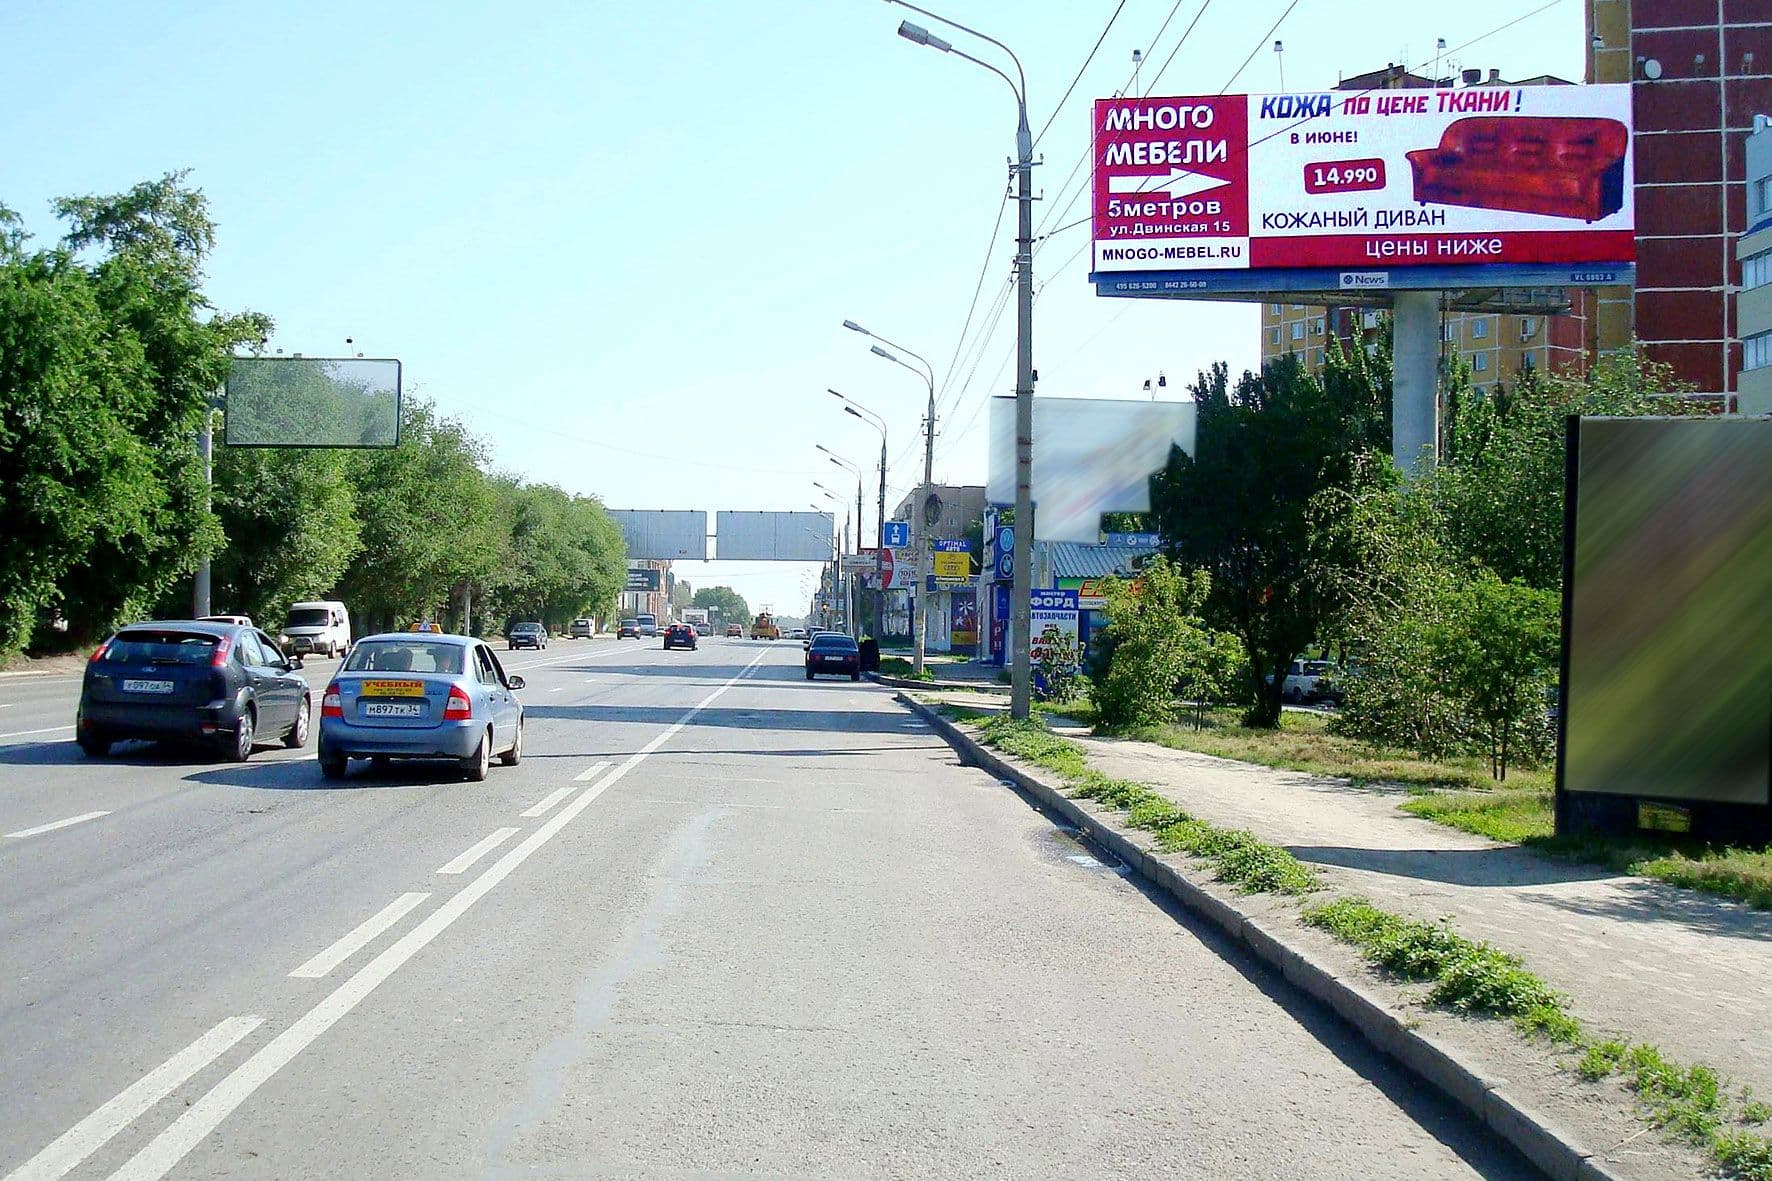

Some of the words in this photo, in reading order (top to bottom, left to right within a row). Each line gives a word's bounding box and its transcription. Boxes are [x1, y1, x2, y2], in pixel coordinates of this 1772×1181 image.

[1260, 95, 1332, 119] КОЖА
[1343, 96, 1371, 115] ПО
[1377, 96, 1430, 116] ЦЕНЕ
[1105, 105, 1214, 131] МНОГО
[1290, 132, 1300, 144] В
[1305, 131, 1358, 144] ИЮНЕ!
[1105, 139, 1227, 166] МЕБЕЛИ
[1314, 167, 1377, 187] 14.990
[1108, 199, 1222, 219] 5метров
[1262, 207, 1368, 230] КОЖАНЫЙ
[1374, 209, 1446, 230] ДИВАН
[1109, 222, 1208, 237] ул.Двинская
[1213, 221, 1231, 232] 15
[1102, 246, 1241, 261] MNOGO-MEBEL.RU
[1366, 239, 1428, 258] цены
[1437, 238, 1503, 255] ниже
[1355, 275, 1385, 284] News
[1030, 596, 1075, 609] ФОРД
[364, 680, 423, 689] УЧЕБНЫЙ
